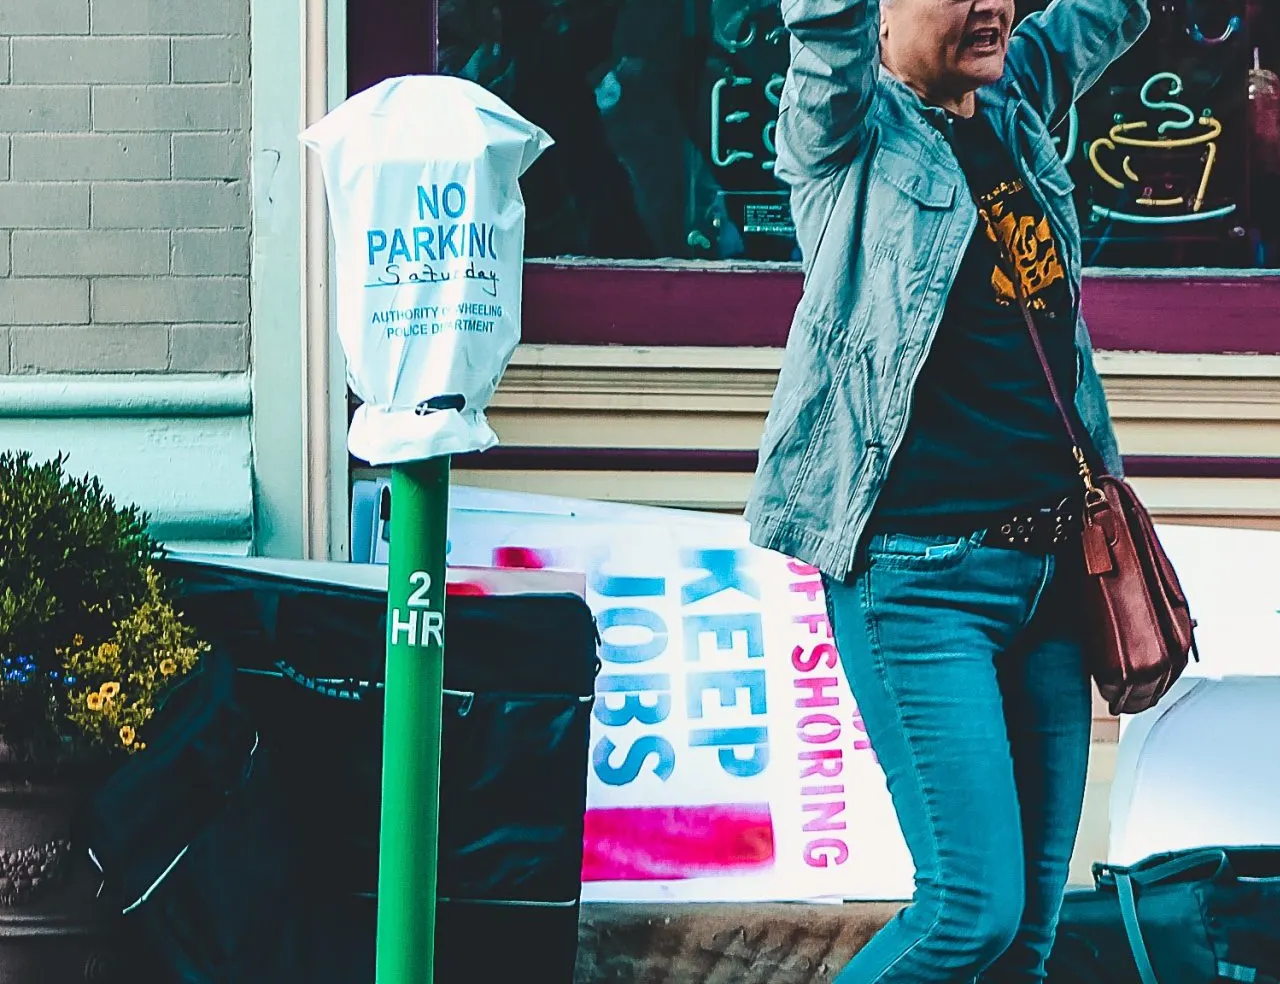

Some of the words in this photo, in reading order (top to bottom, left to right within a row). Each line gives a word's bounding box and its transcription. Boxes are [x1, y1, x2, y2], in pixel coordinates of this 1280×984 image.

[417, 181, 467, 220] NO
[387, 323, 428, 338] POLICE
[407, 571, 432, 608] 2
[391, 609, 443, 647] HR
[588, 547, 676, 787] JOBS
[679, 548, 771, 778] KEEP
